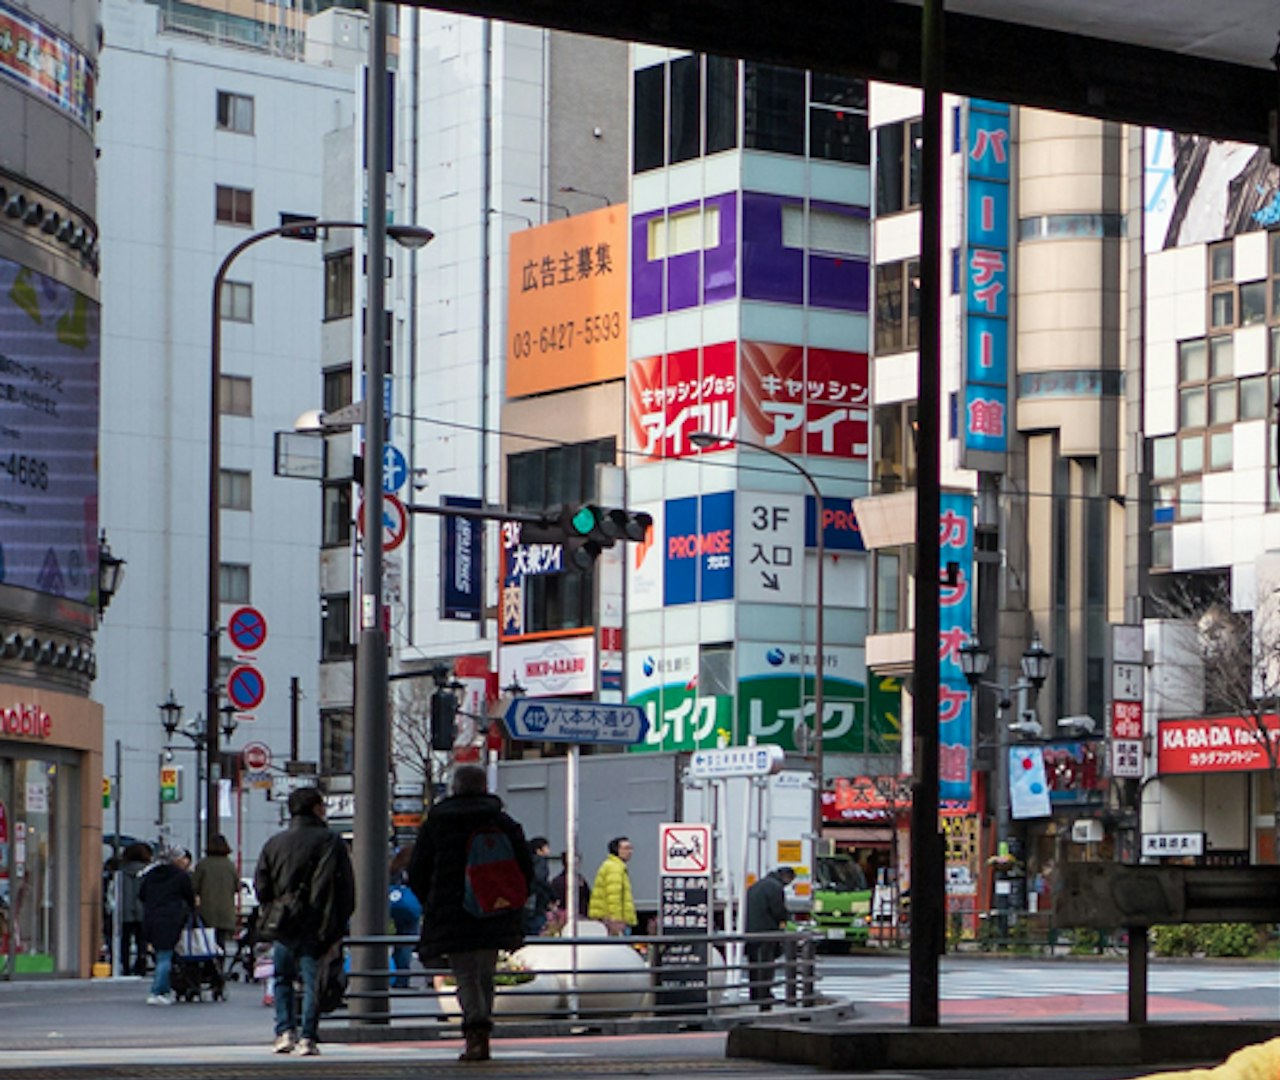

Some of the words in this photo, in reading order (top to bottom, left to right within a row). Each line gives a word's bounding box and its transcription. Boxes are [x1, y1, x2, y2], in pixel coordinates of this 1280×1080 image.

[522, 243, 612, 292] 広告主募集
[513, 311, 620, 359] 03-6427-5593
[752, 506, 789, 531] 3F
[669, 529, 731, 559] PROMISE
[750, 543, 792, 566] 入口
[526, 708, 546, 728] 412
[552, 707, 634, 727] 六本木通り
[646, 696, 717, 744] レイク
[751, 699, 855, 739] レイク
